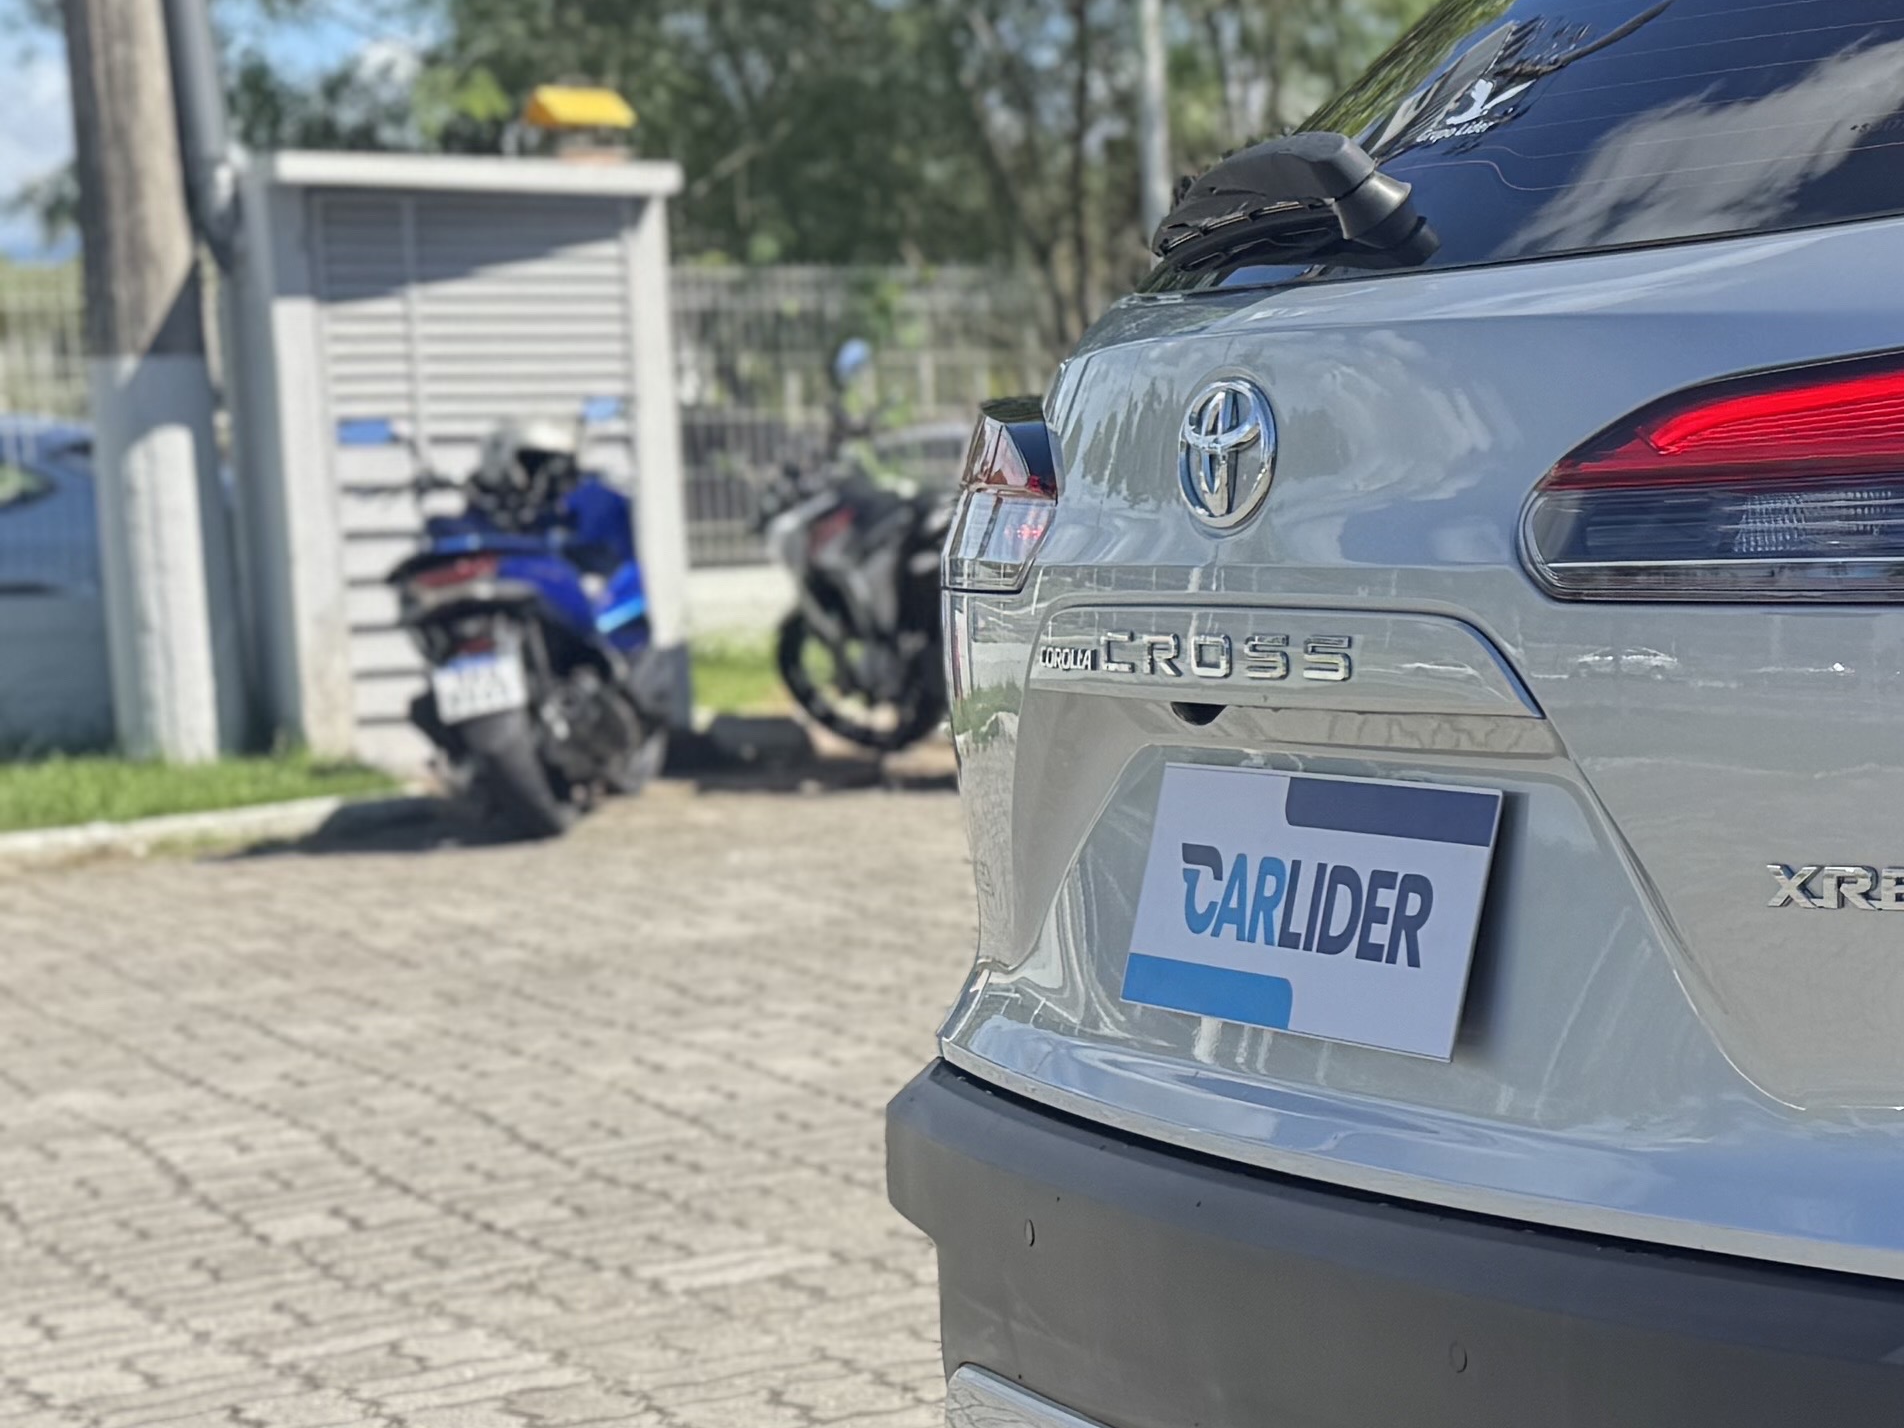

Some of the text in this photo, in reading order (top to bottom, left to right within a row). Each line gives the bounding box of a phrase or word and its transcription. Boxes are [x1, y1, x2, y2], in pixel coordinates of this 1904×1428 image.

[1037, 629, 1354, 682] COROLLA CROSS
[1181, 842, 1434, 969] CARLIDER
